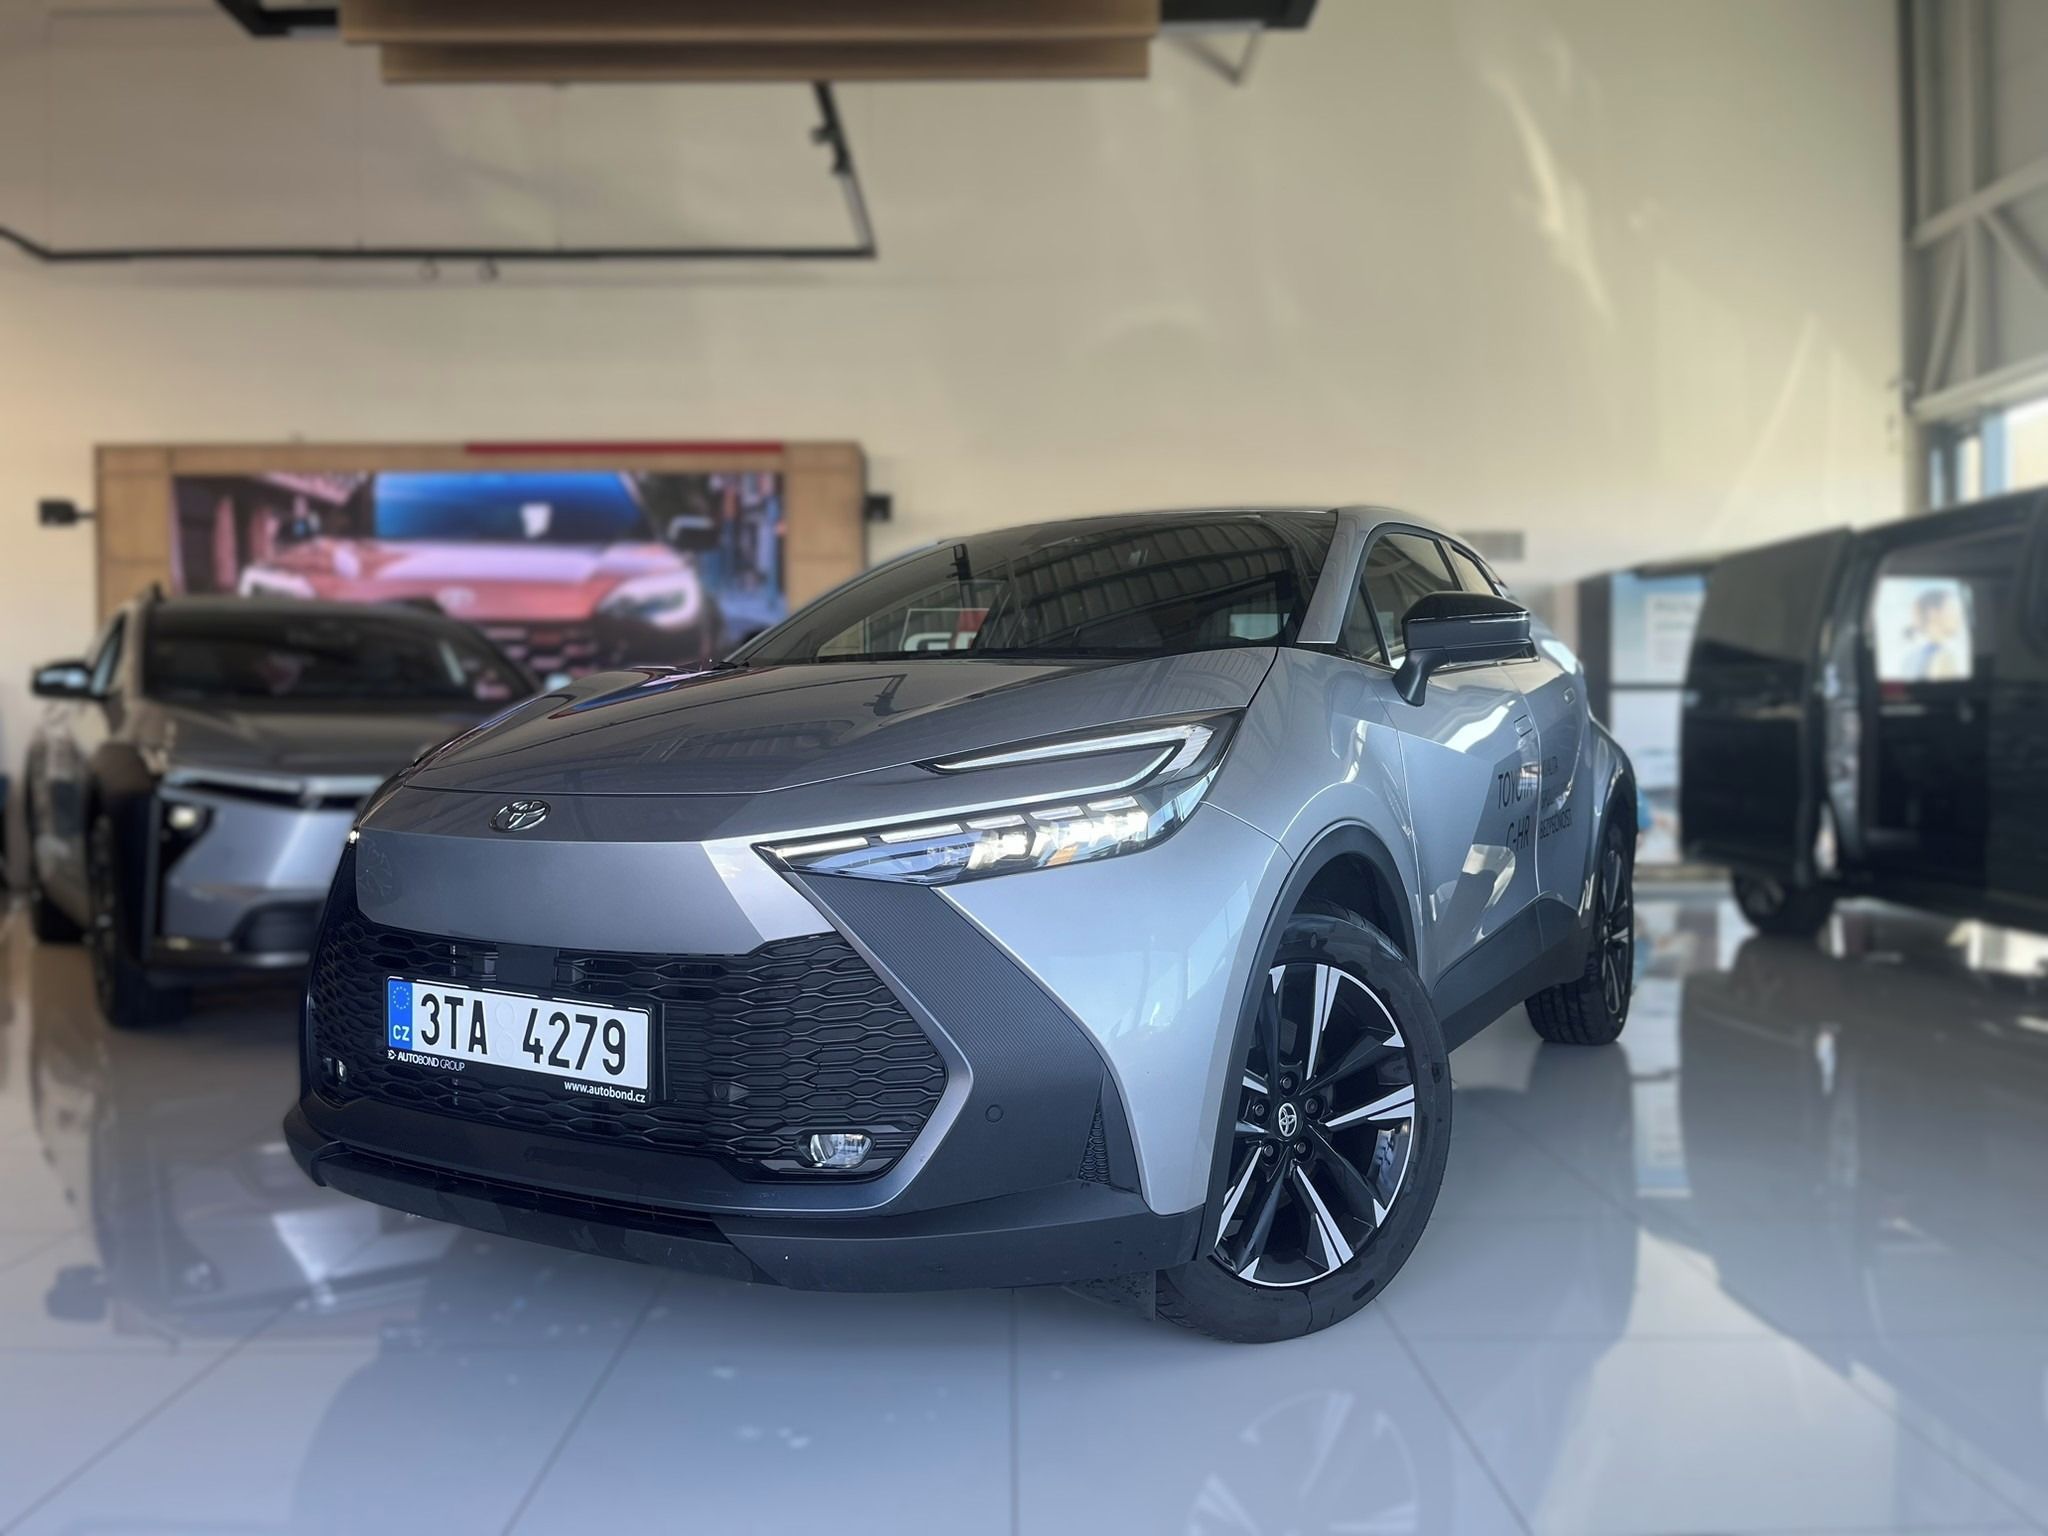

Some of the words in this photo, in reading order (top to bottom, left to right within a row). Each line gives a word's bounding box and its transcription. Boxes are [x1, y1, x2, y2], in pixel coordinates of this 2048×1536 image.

[392, 1024, 410, 1042] CZ
[420, 993, 488, 1055] 3TA
[522, 1008, 626, 1076] 4279
[397, 1051, 439, 1067] AUTOBOND
[440, 1058, 465, 1072] GROUP
[564, 1081, 646, 1103] www.autobond.cz
